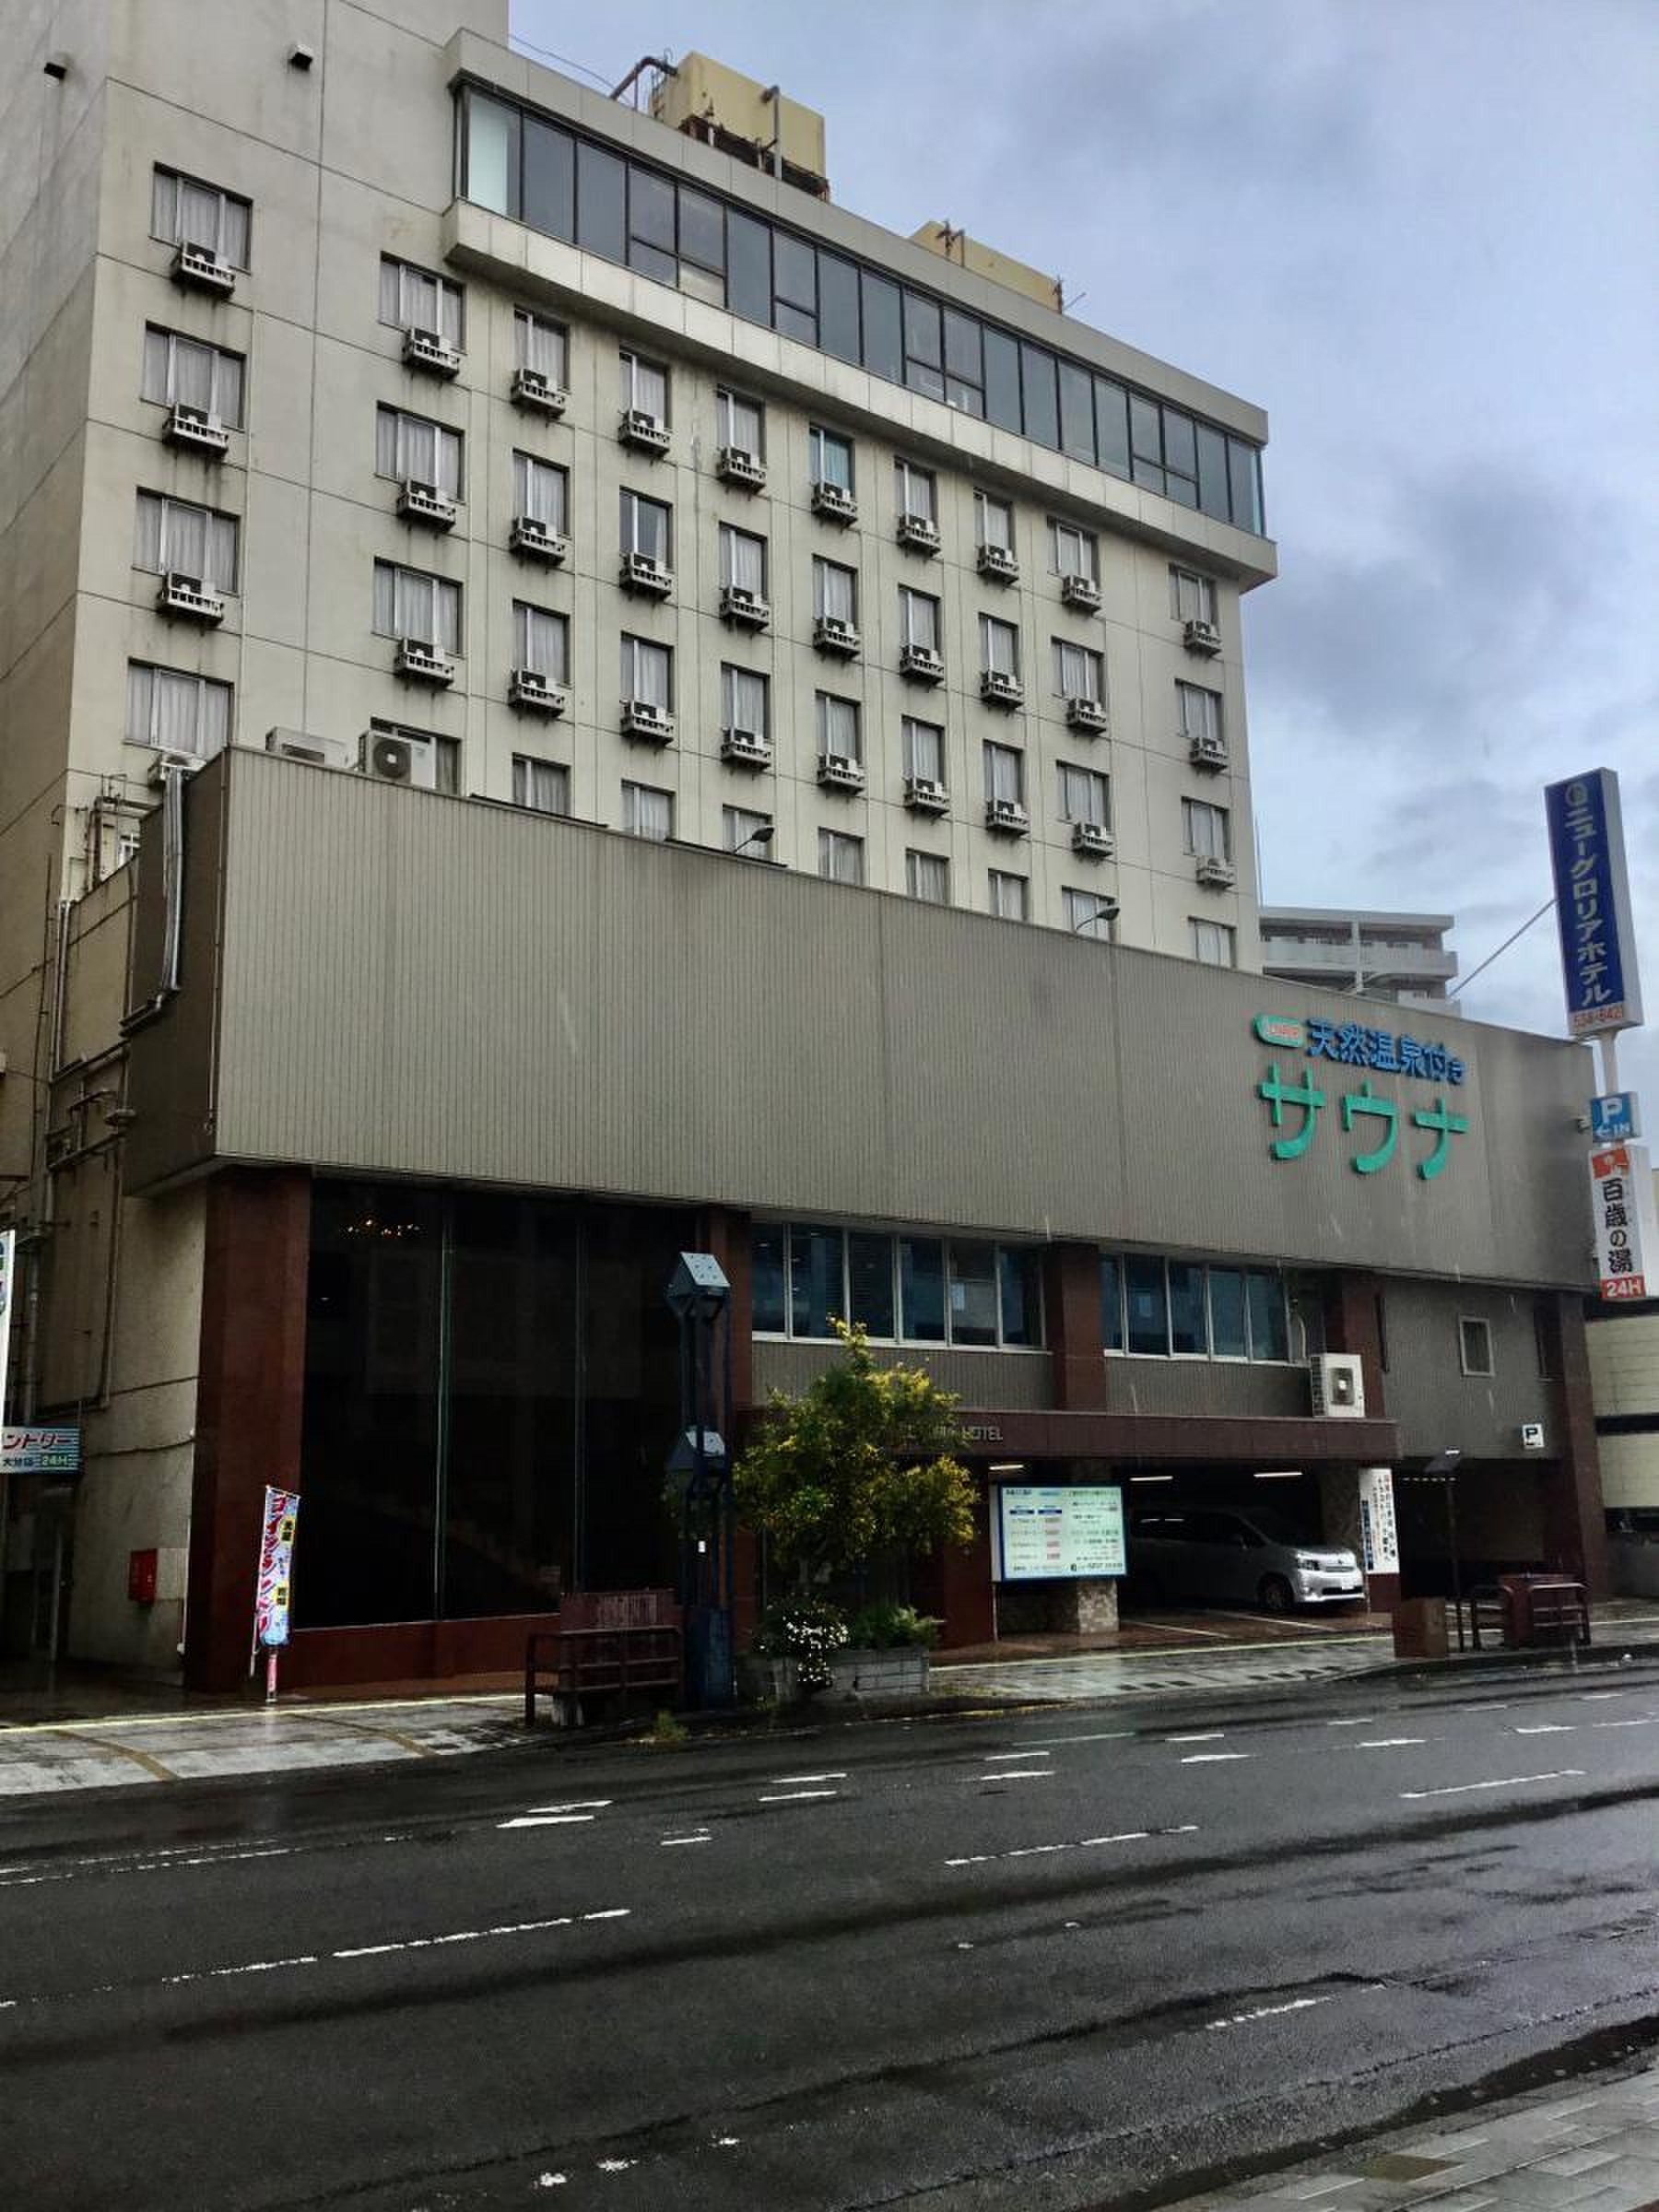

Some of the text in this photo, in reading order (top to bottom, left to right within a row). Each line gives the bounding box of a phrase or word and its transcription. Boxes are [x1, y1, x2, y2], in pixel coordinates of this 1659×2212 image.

[1564, 807, 1612, 1006] ニューグロリアホテル
[1306, 1017, 1467, 1085] 天然温泉付き
[1260, 1061, 1470, 1181] サウナ
[1601, 1097, 1623, 1122] P
[1602, 1177, 1633, 1274] 百歳の湯
[1606, 1277, 1642, 1298] 24H
[1525, 1428, 1538, 1440] P
